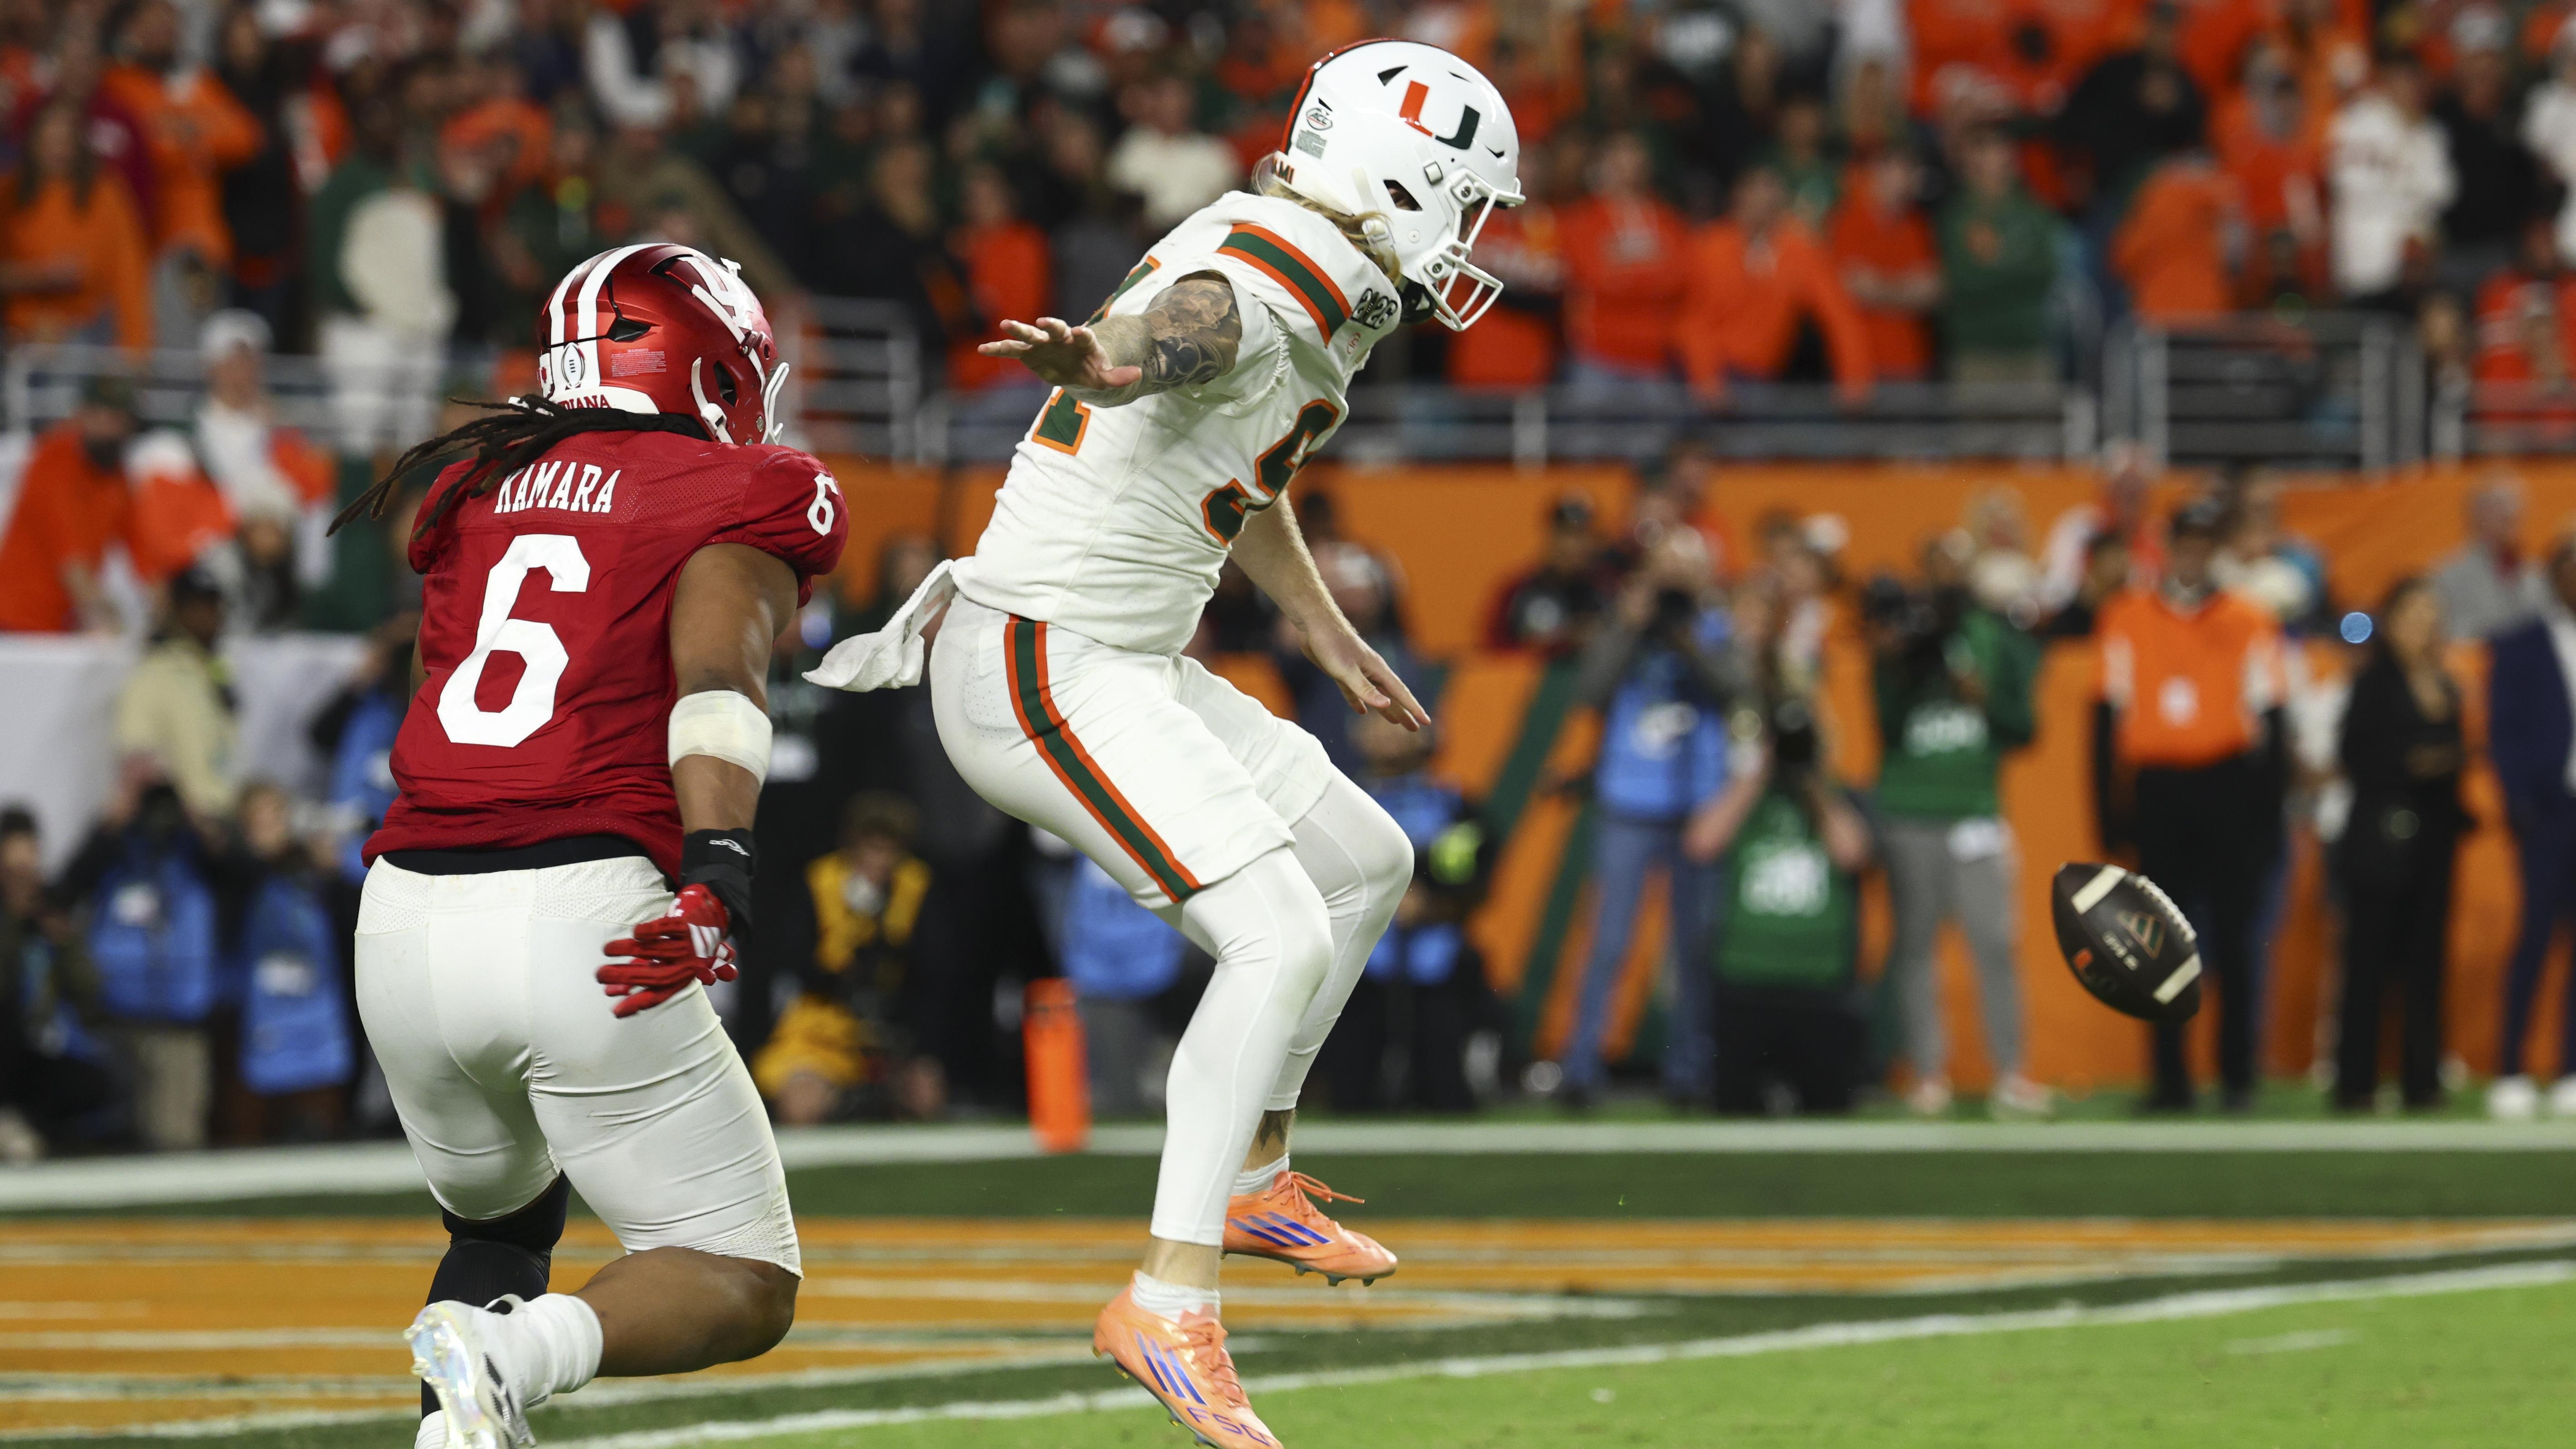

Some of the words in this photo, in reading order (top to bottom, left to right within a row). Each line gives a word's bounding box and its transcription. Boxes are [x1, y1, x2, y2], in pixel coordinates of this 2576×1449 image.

[1399, 80, 1480, 150] U
[557, 394, 612, 410] DIANA
[494, 461, 621, 514] KAMARA
[807, 473, 839, 536] 6
[437, 534, 591, 748] 6
